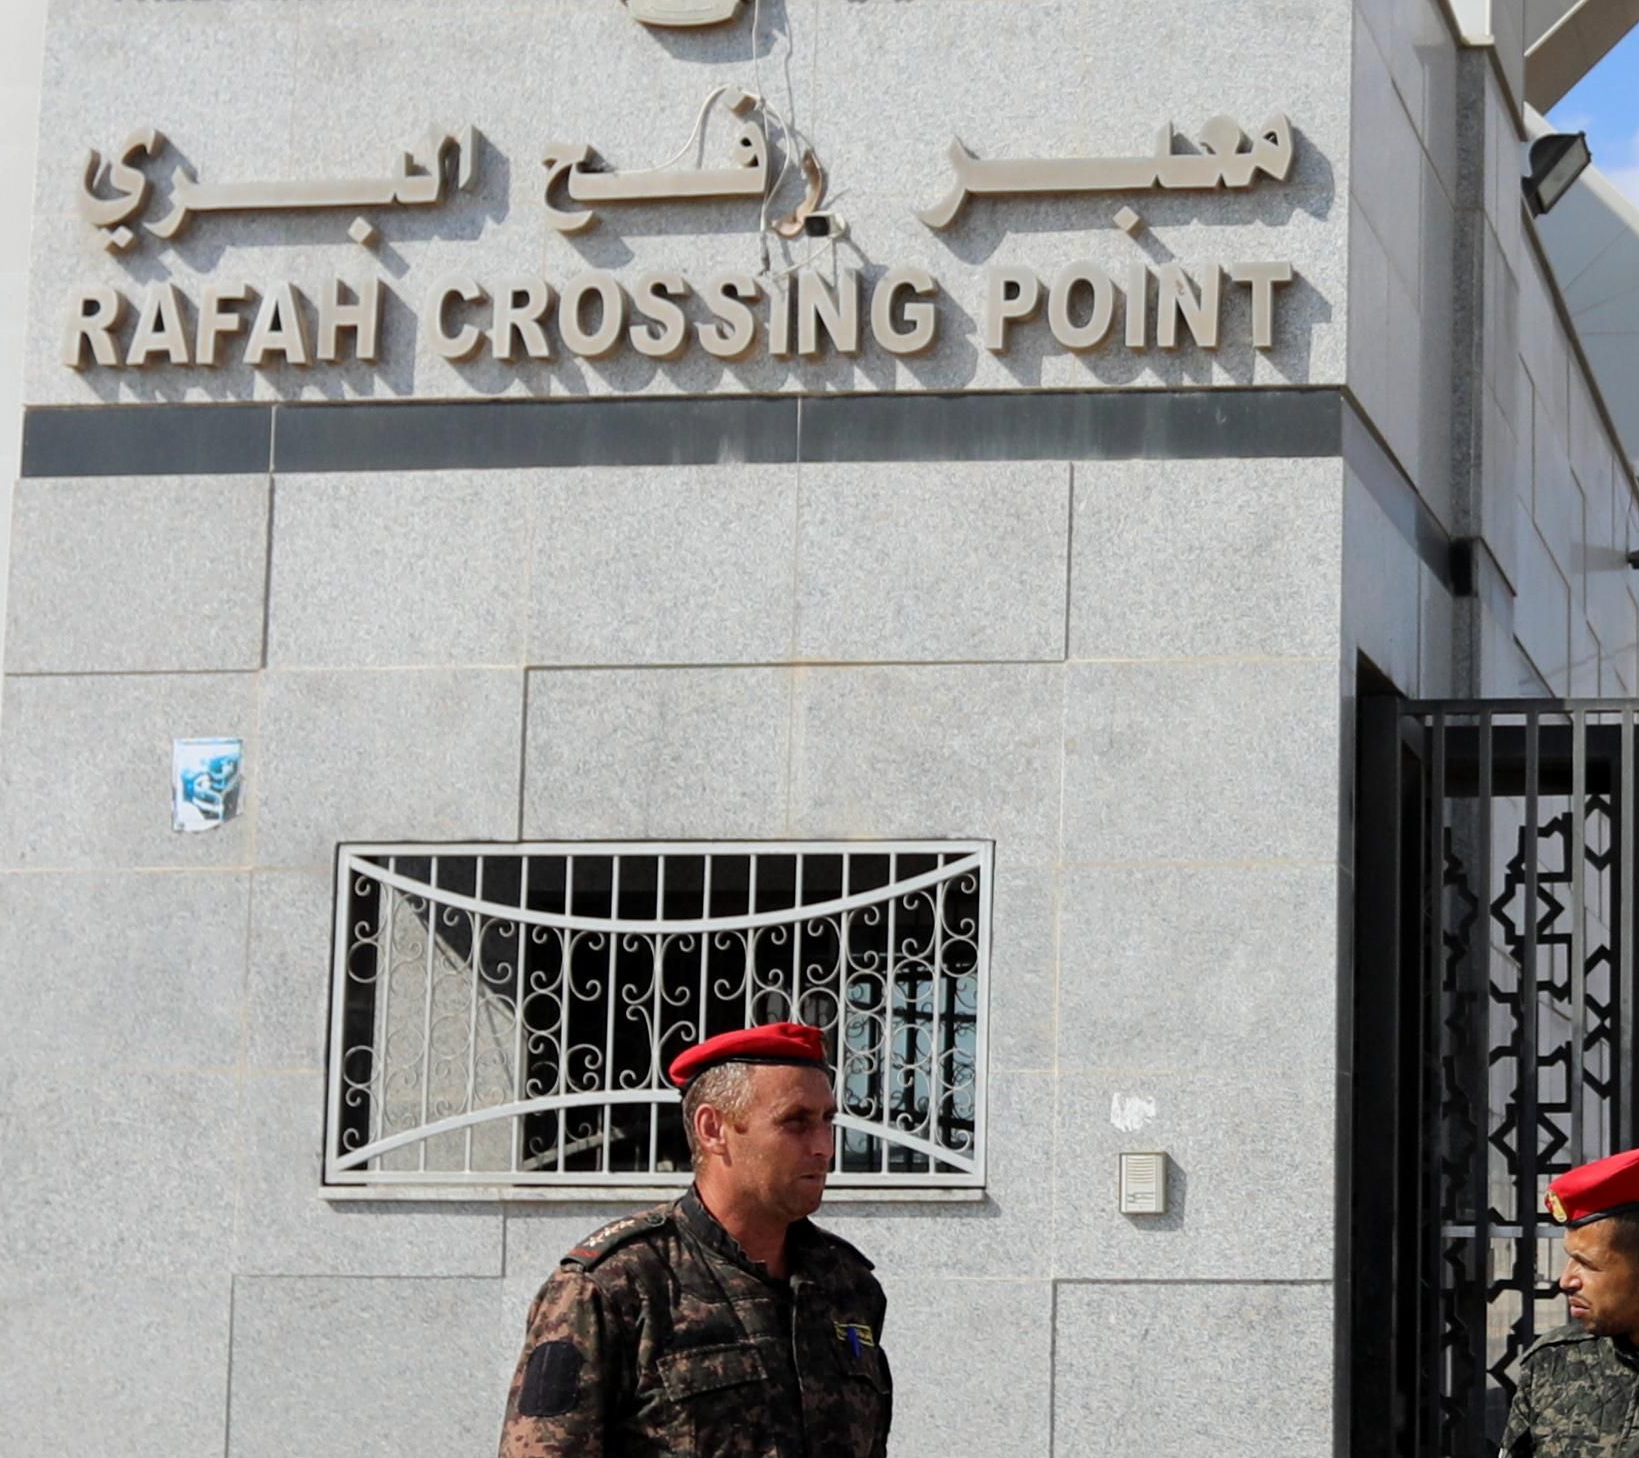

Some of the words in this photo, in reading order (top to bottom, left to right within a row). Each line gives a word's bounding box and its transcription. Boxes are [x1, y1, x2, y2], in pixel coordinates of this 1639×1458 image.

[78, 123, 481, 254] البري
[542, 84, 826, 238] رفح
[913, 112, 1293, 235] معبر
[62, 276, 384, 368] RAFAH
[426, 263, 938, 363] CROSSING
[984, 260, 1293, 352] POINT
